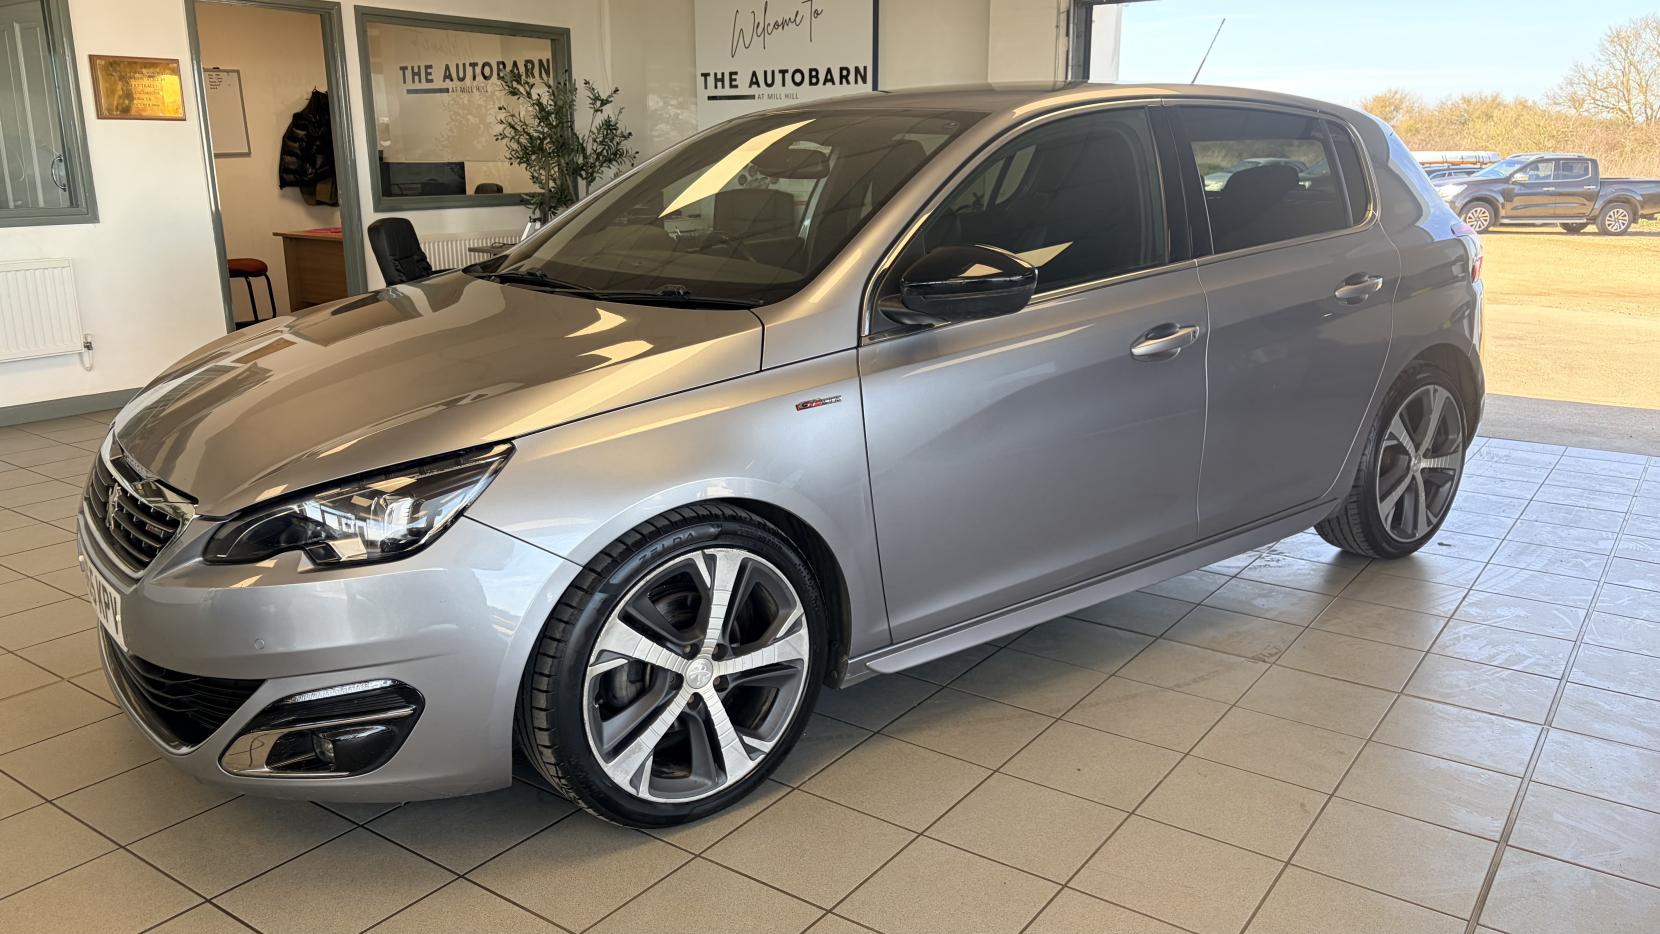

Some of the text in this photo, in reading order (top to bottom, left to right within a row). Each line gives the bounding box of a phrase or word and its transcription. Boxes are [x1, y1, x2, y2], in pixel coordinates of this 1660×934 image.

[730, 0, 823, 58] Welcome To
[399, 58, 551, 84] THE AUTOBARN
[701, 66, 867, 90] THE AUTOBARN
[767, 92, 782, 100] MILL
[784, 92, 799, 100] HILL
